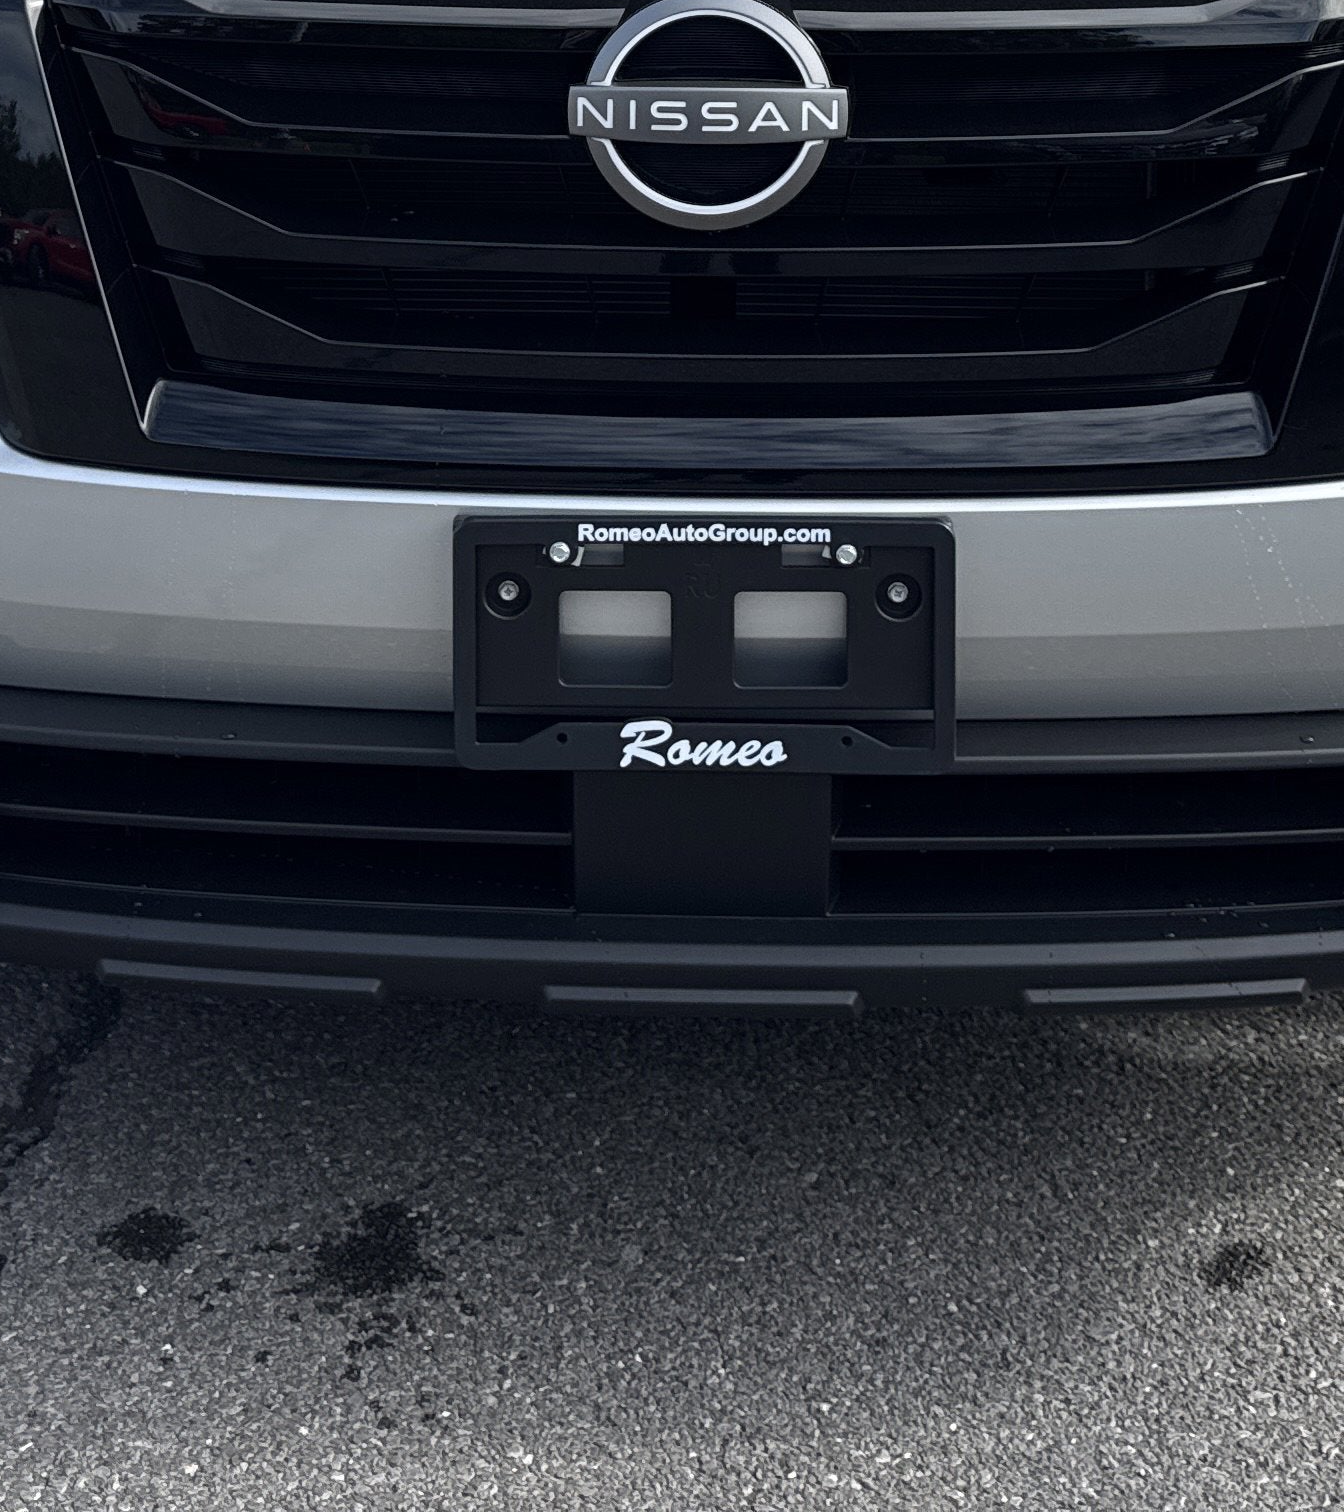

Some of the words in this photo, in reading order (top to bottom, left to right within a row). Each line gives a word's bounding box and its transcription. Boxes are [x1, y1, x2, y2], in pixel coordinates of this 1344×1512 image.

[576, 96, 839, 132] NISSAN
[577, 523, 831, 546] RomeoAutoGroup.com
[619, 720, 788, 768] Romeo
